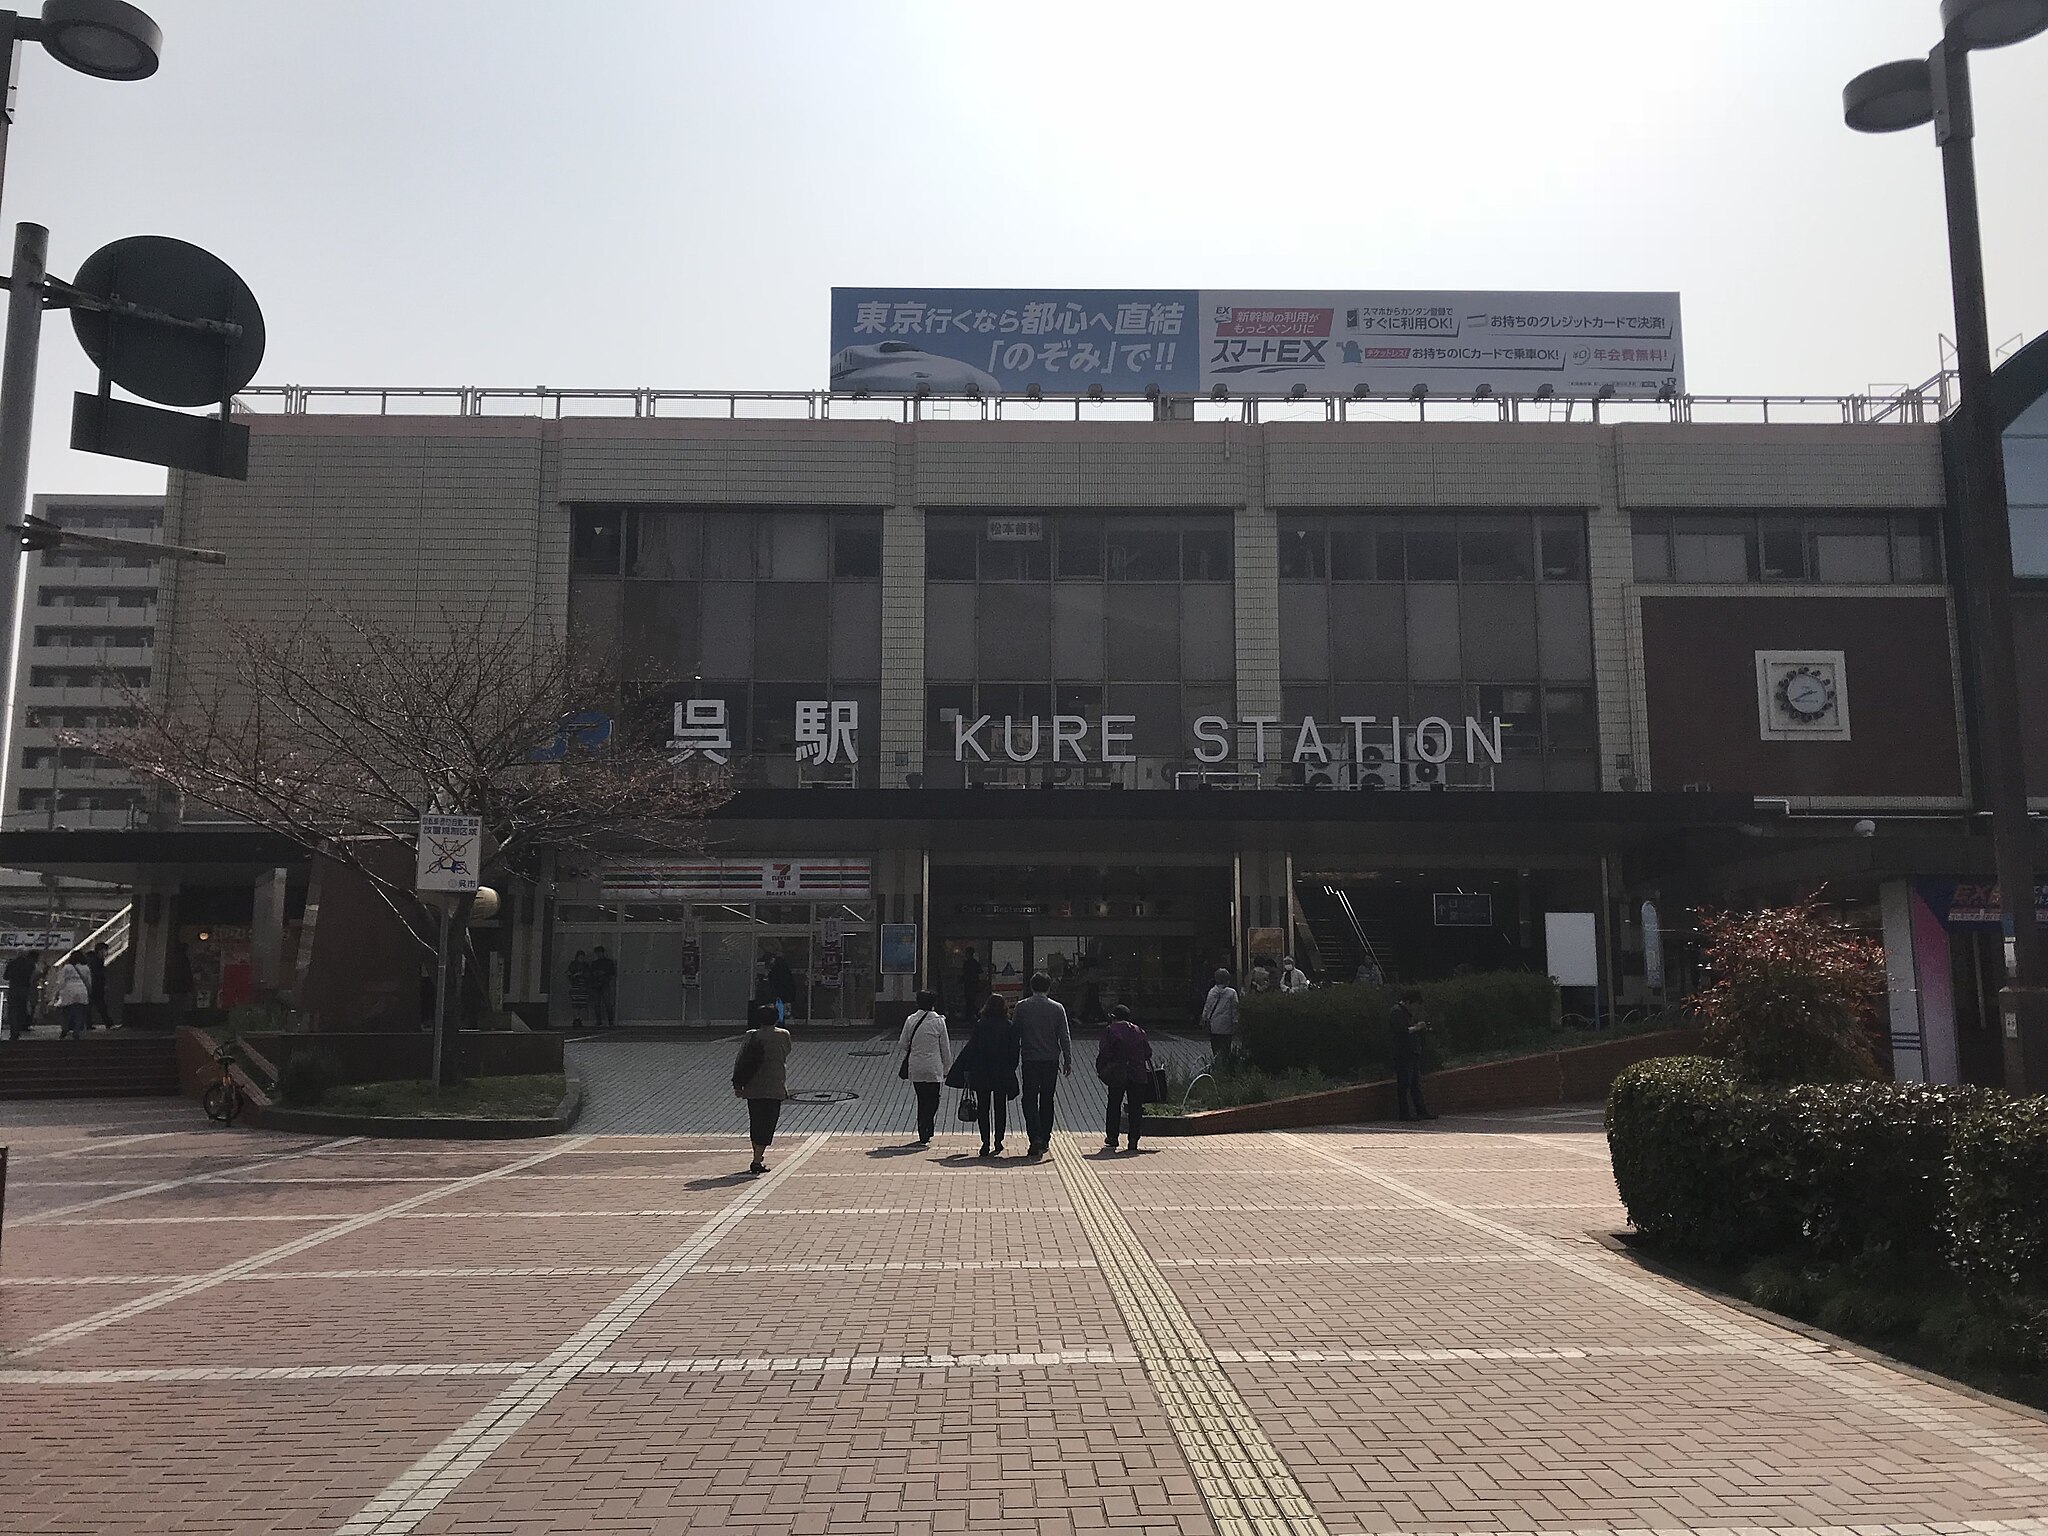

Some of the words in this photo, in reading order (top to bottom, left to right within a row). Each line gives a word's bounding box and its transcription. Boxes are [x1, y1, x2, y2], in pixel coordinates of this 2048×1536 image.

[1216, 306, 1231, 314] EX
[853, 301, 1185, 336] 東京行くなら都心へ直結
[1236, 311, 1320, 323] 新幹線の利用が
[1363, 317, 1453, 330] すぐに利用OK!
[1490, 315, 1666, 329] お持ちのクレジットカードで決済!
[1233, 323, 1315, 334] もっとベンリに
[1211, 339, 1329, 363] スマートEX
[1412, 348, 1559, 360] お持ちのICカードで乗車OK!
[1593, 349, 1668, 362] 年会費無料!
[955, 714, 1137, 764] KURE
[1193, 714, 1504, 764] STATION
